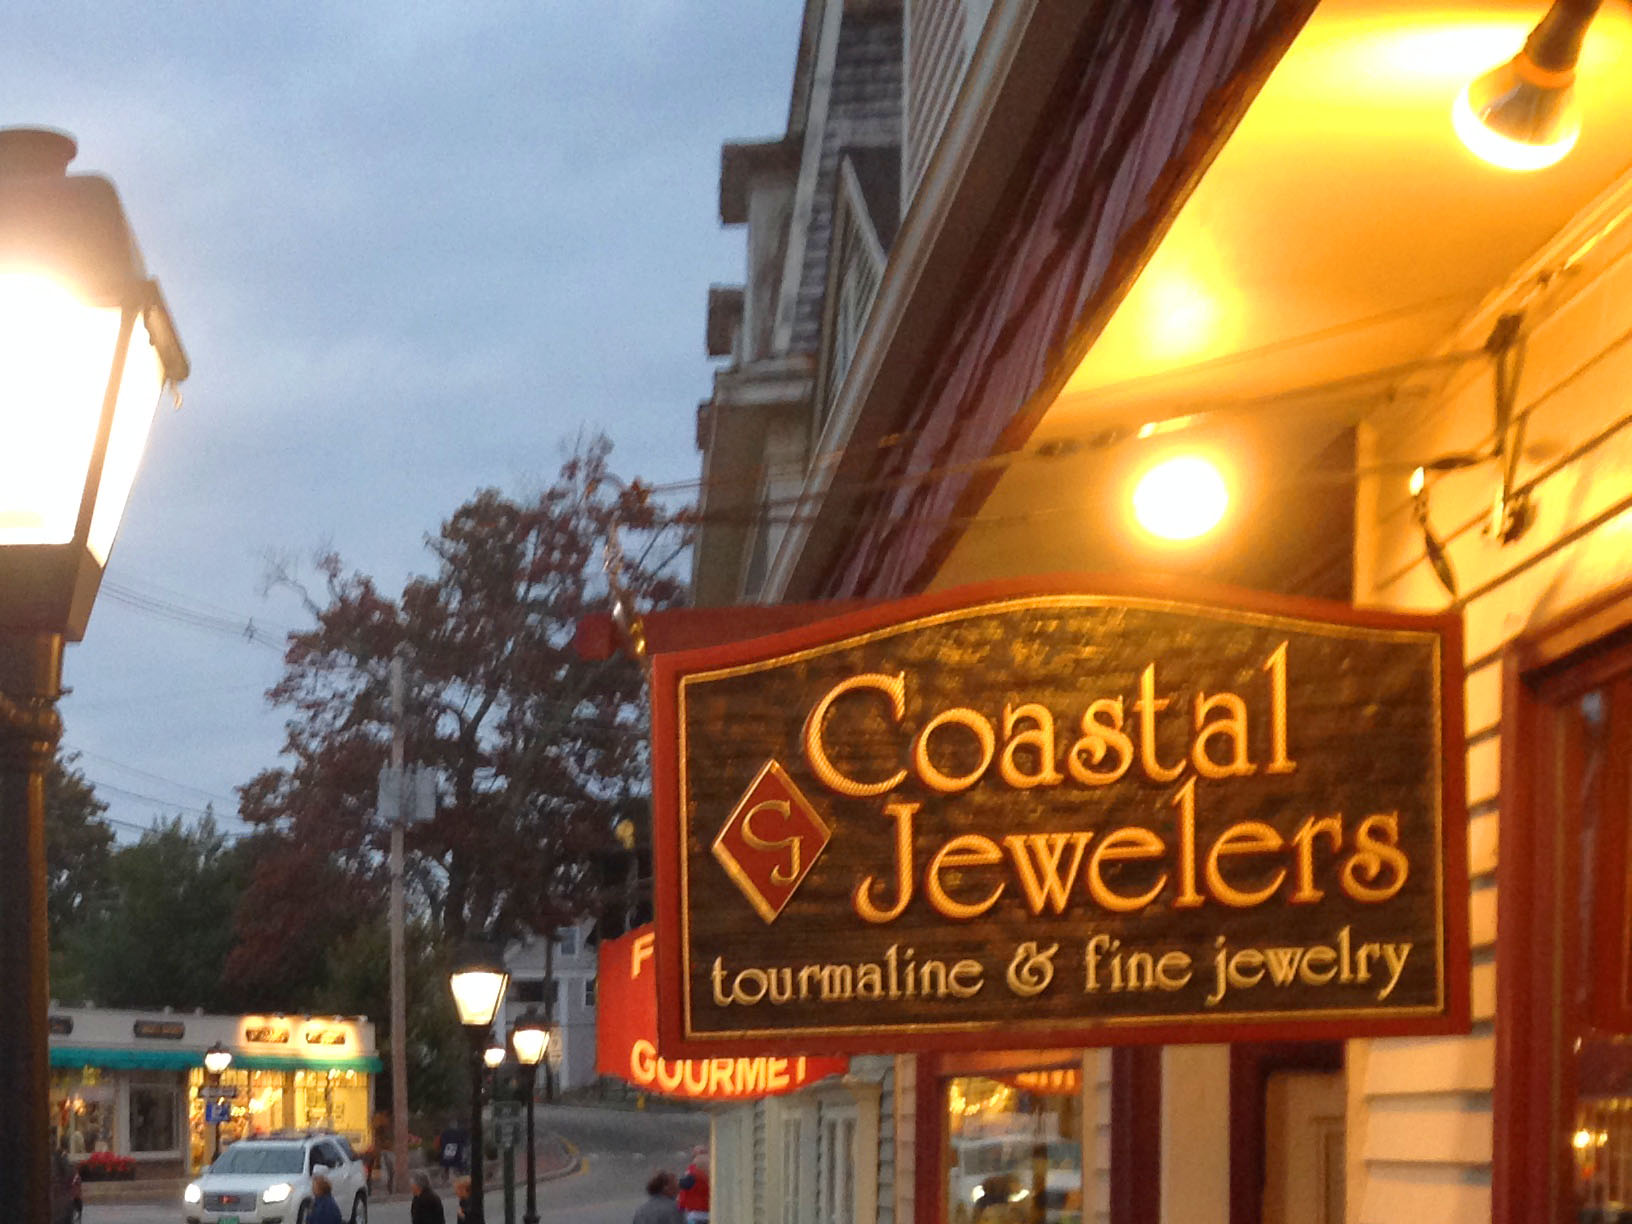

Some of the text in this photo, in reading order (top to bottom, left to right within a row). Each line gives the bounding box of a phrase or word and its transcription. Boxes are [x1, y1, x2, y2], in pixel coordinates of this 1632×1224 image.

[805, 641, 1298, 797] Coastal
[854, 774, 1410, 923] Jewelers
[711, 944, 985, 1006] tourmaline
[1006, 941, 1058, 997] &
[1084, 934, 1194, 993] fine
[1207, 926, 1413, 1006] jewelry
